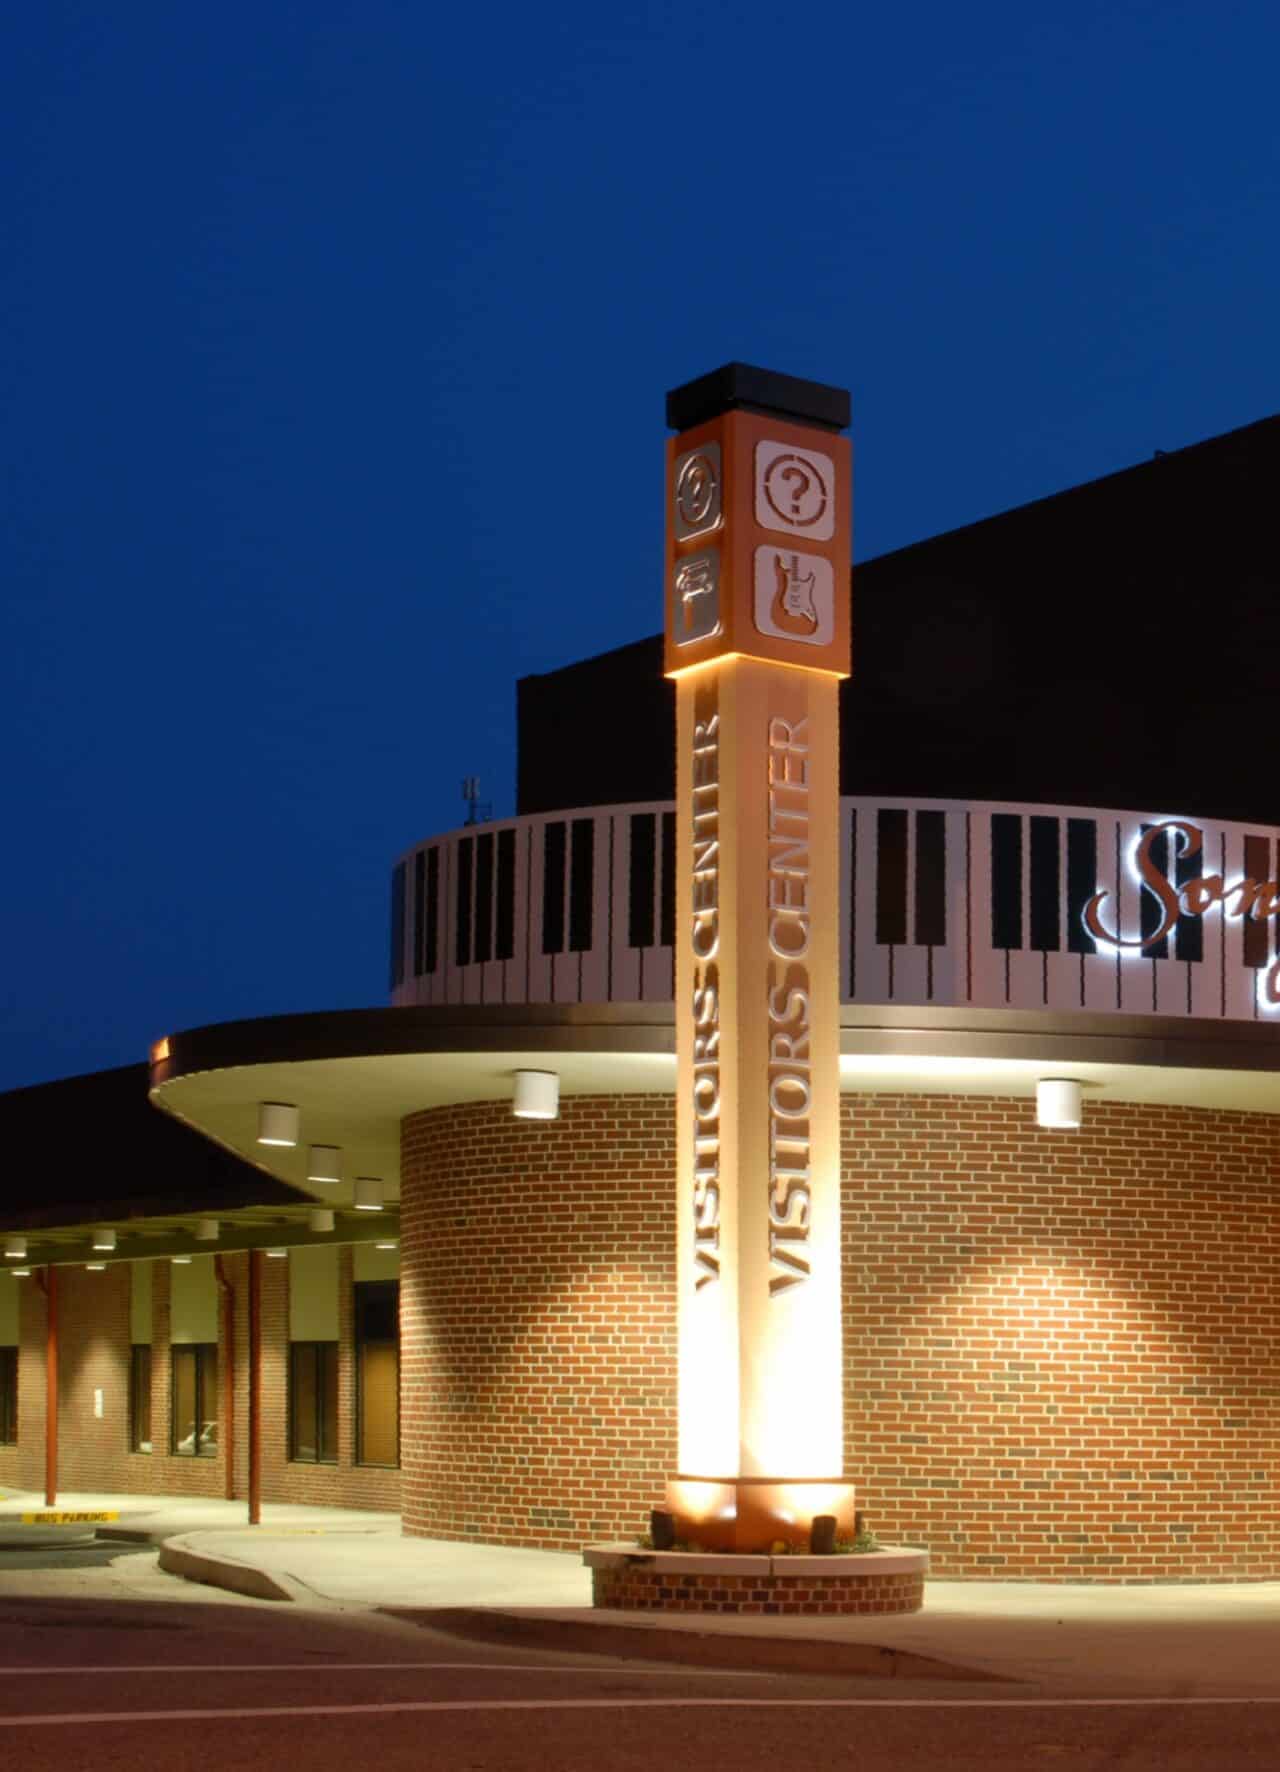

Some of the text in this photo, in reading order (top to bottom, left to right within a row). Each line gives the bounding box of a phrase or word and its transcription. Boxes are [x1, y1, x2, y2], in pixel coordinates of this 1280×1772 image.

[692, 714, 720, 1292] VISITORS CENTER
[768, 716, 811, 1296] VISITORS CENTER
